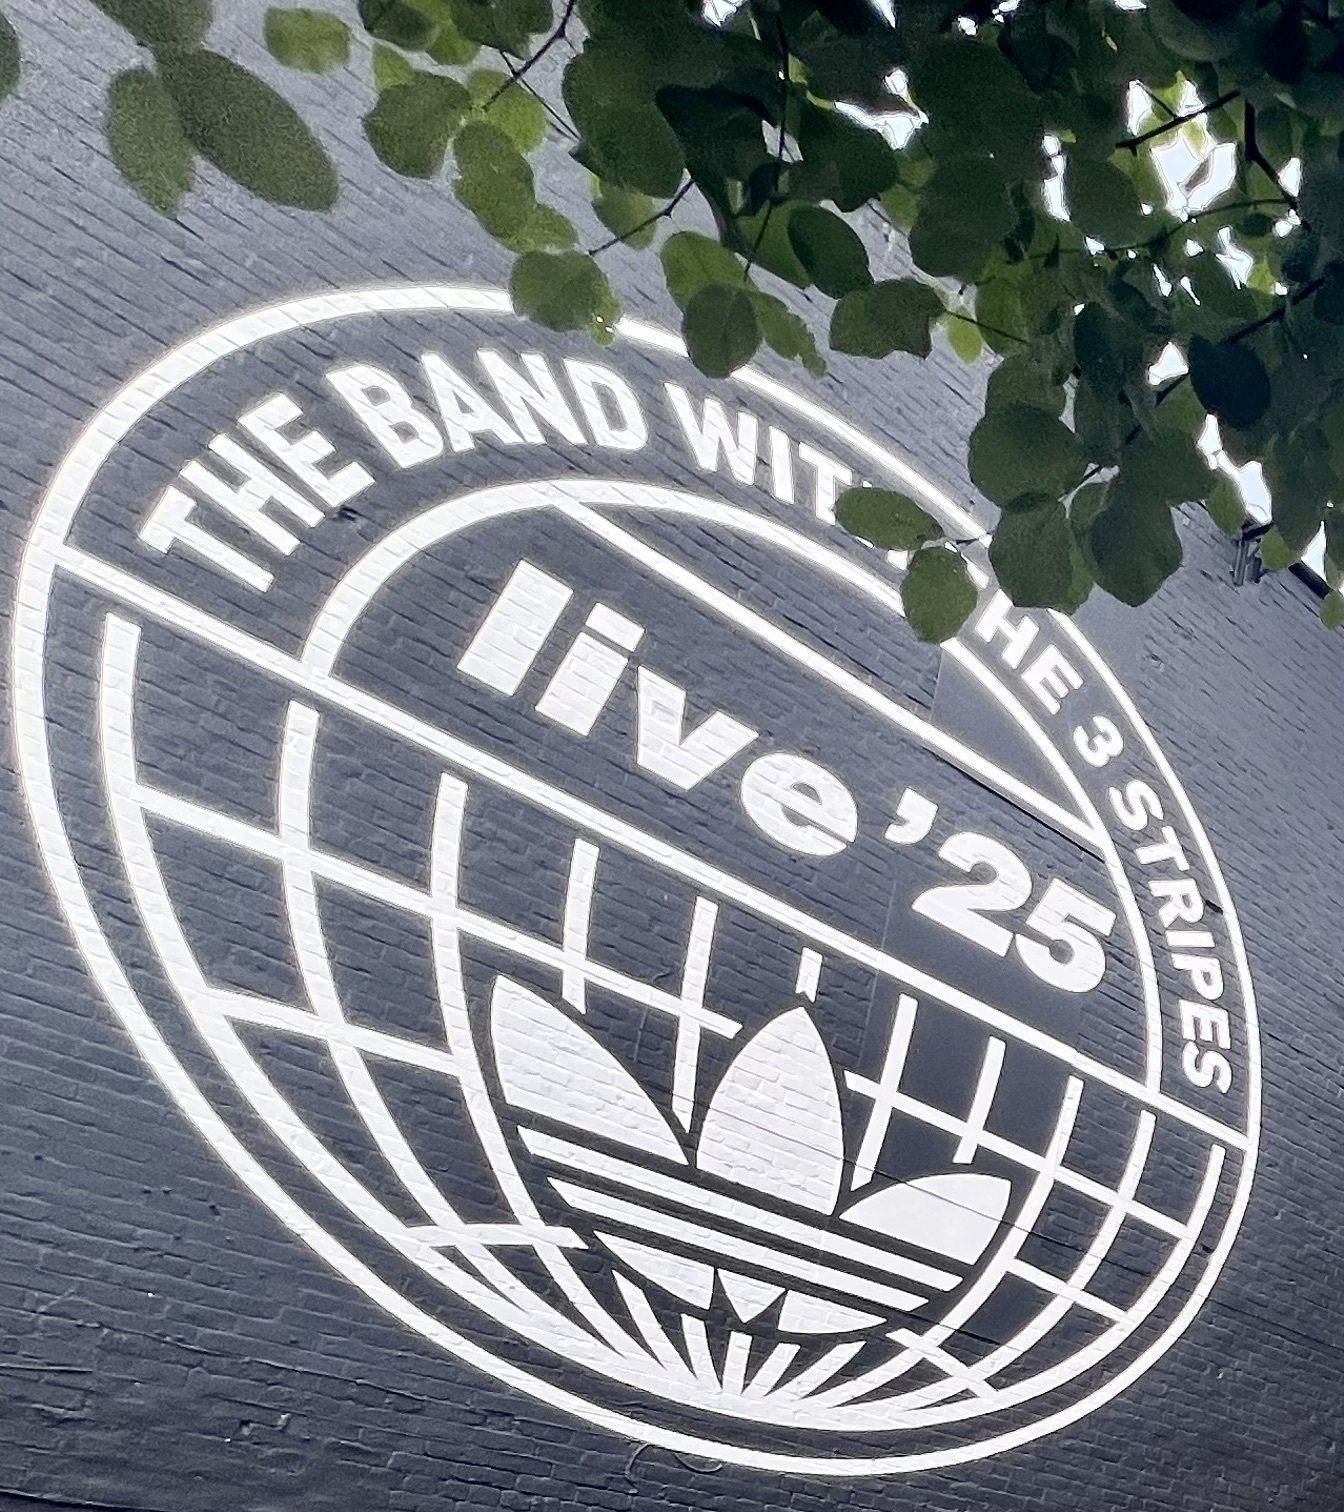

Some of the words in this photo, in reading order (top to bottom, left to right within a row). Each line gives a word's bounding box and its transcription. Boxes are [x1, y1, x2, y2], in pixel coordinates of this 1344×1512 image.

[136, 391, 377, 594] THE
[324, 347, 650, 470] BAND
[663, 381, 910, 572] WIT
[1072, 714, 1125, 769] 3
[1107, 778, 1233, 1096] STRIPES
[455, 558, 860, 858] live
[883, 786, 1118, 994] '25
